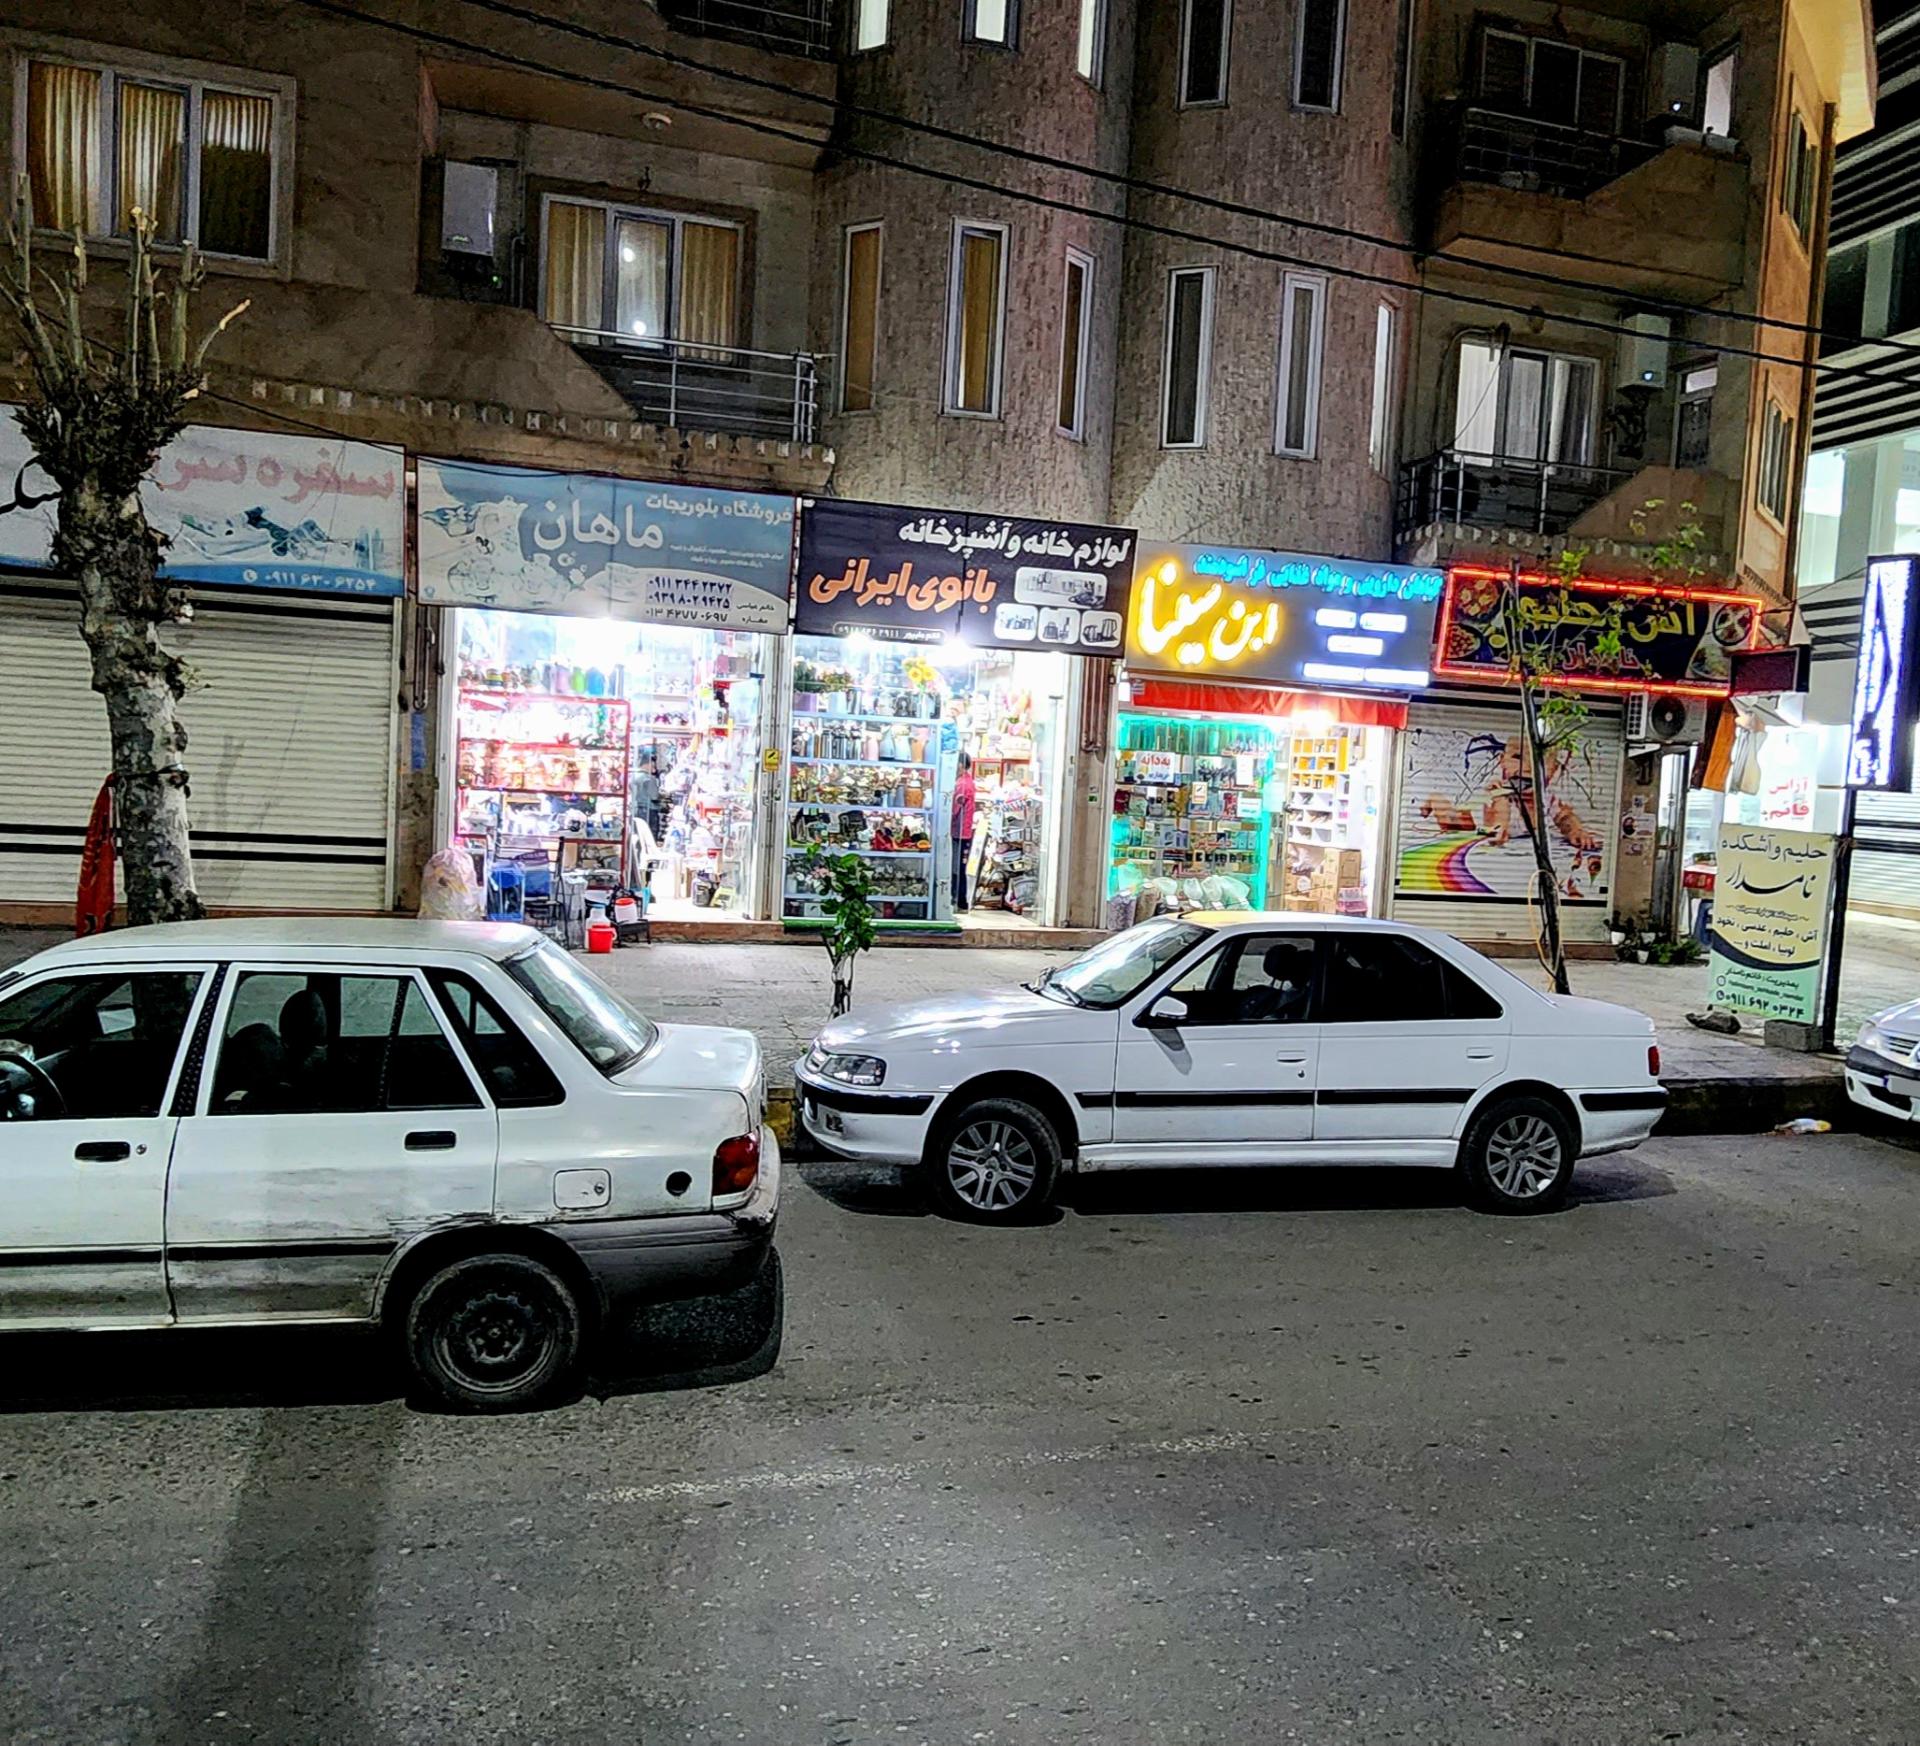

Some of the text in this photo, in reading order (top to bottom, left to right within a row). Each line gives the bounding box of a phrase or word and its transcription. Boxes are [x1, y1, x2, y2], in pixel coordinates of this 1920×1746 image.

[256, 447, 395, 504] سفره
[534, 499, 663, 550] ماهان
[646, 494, 793, 525] فروشگاه بلوریجات
[899, 518, 1131, 568] لوازم خانه و آشپزخانه
[649, 576, 671, 588] ۰۹۱۱
[809, 559, 996, 613] بانوی ایرانی
[1138, 562, 1279, 664] ابن سینا
[1722, 833, 1827, 862] حلیم و آشکده
